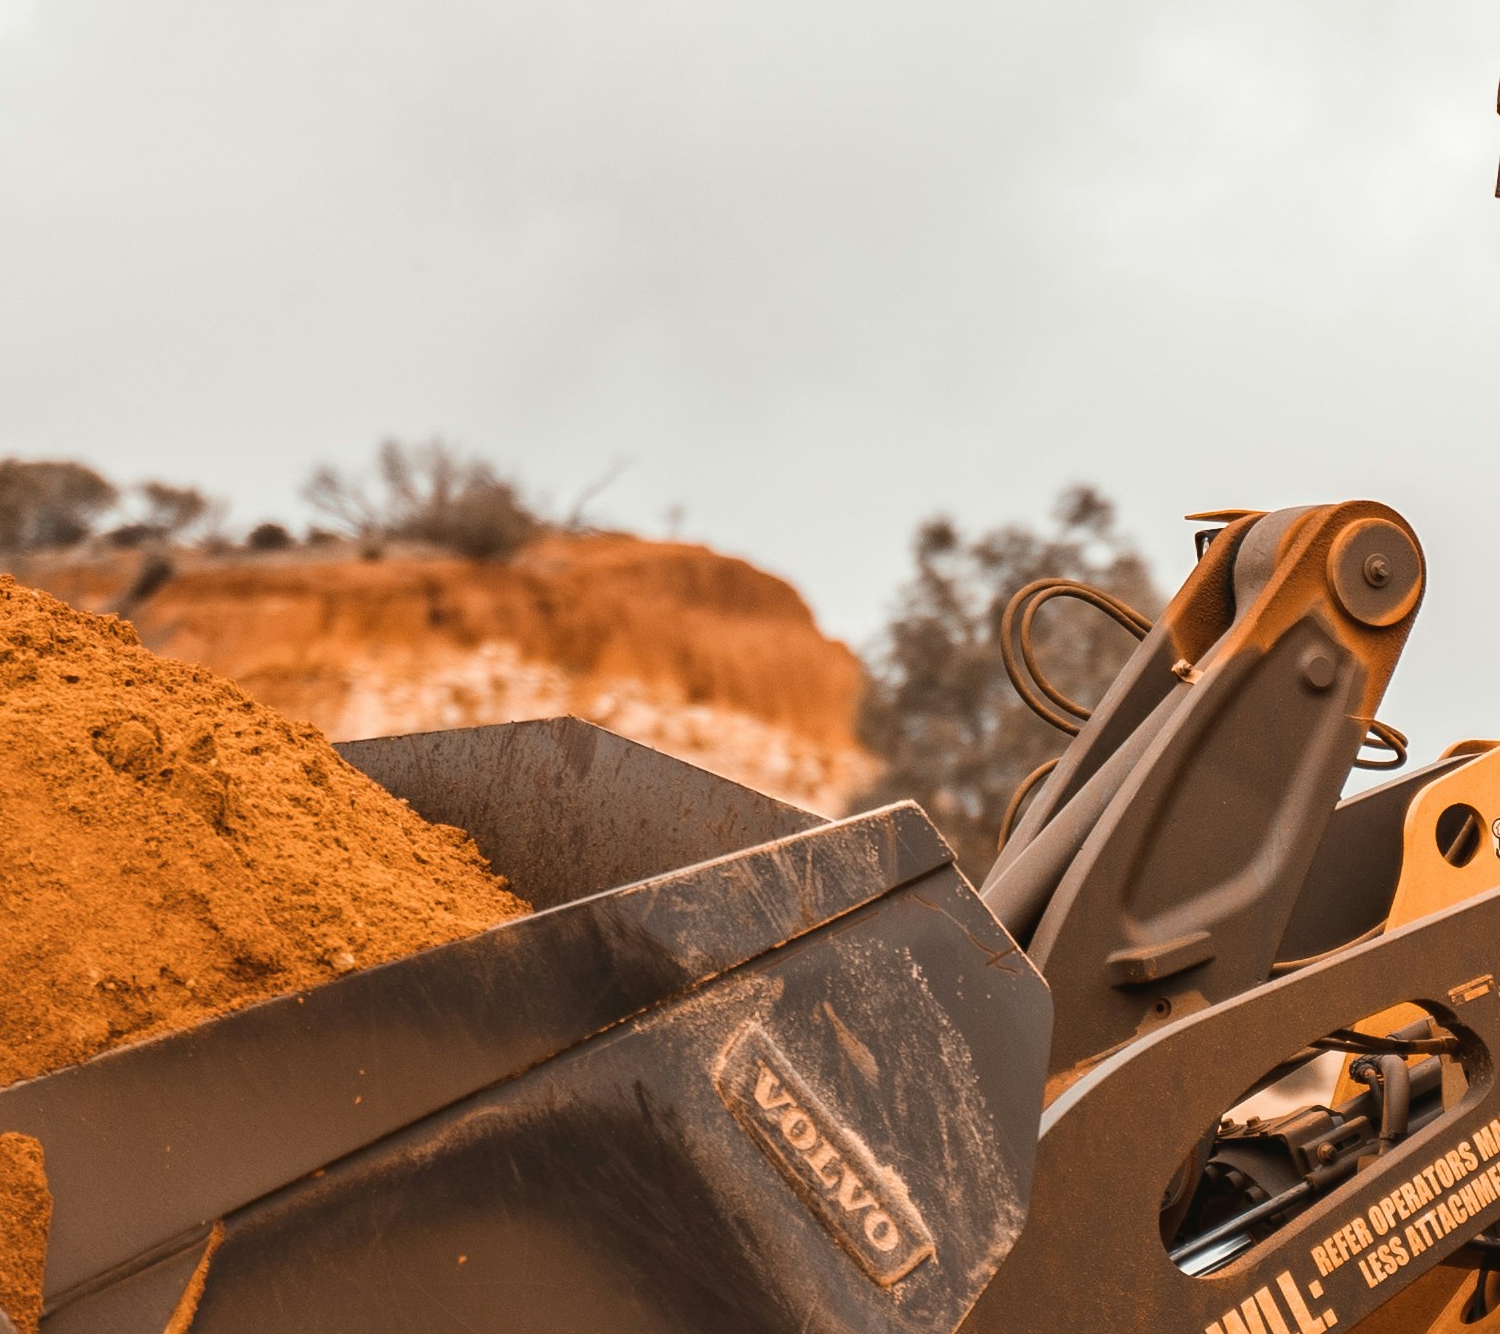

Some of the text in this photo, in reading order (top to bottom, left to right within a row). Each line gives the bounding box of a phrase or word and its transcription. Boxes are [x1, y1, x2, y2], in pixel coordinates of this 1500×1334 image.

[753, 1057, 901, 1253] VOLVO
[1310, 1217, 1375, 1277] REFER
[1368, 1141, 1479, 1236] OPERATORS
[1358, 1236, 1410, 1289] LESS
